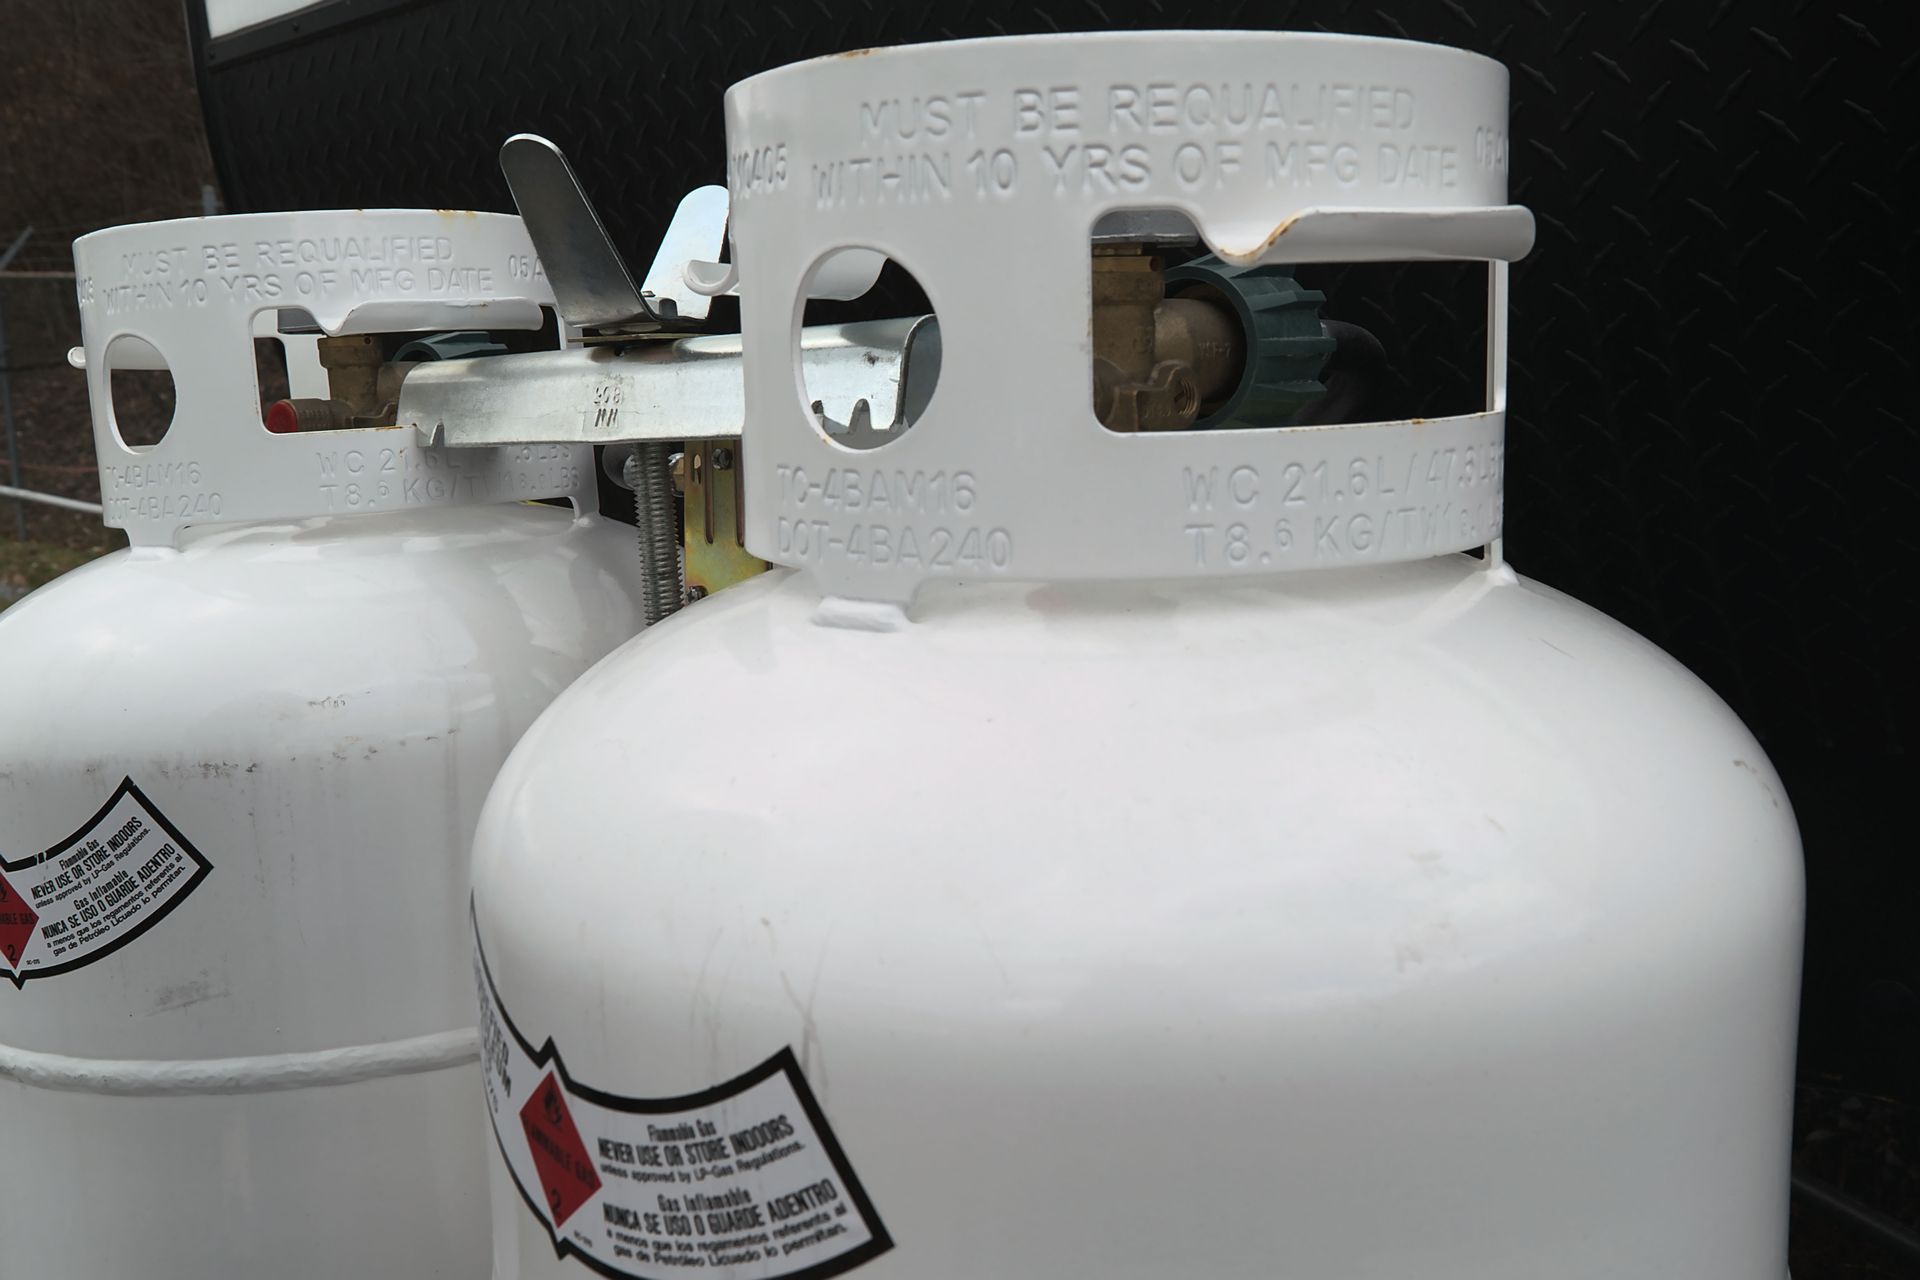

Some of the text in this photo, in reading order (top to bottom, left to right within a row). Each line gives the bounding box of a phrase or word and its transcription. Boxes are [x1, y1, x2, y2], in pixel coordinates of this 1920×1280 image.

[859, 81, 1416, 151] MUST BE REQUALIFIED
[811, 138, 1459, 213] WITHIN 10 YRS OF MFG DATE
[122, 236, 455, 281] MUST BE REQUALIFIED
[102, 281, 173, 315] WITHIN
[180, 277, 209, 309] 10
[219, 273, 283, 304] YRS
[295, 268, 338, 297] OF
[350, 267, 416, 296] MFG
[426, 266, 495, 293] DATE
[777, 463, 977, 517] TC-4BAM16
[31, 816, 142, 900] NEVER USE OR STORE INDOORS
[35, 828, 151, 909] unless approved by LP-Gas Regulations.
[59, 839, 100, 870] Flammable Gas
[41, 843, 176, 940] NUNCA SE USO O GUARDE ADENTRO
[53, 934, 75, 947] menos
[76, 926, 90, 937] que
[90, 920, 102, 929] los
[176, 853, 184, 863] al
[53, 947, 67, 958] gas
[68, 941, 78, 951] de
[110, 904, 142, 927] Licuado
[143, 896, 151, 905] lo
[151, 866, 186, 899] permitan.
[73, 870, 129, 911] Gas Inflamable
[7, 943, 17, 963] 2
[598, 1113, 795, 1167] NEVER USE OR STORE INDOORS
[657, 1192, 681, 1212] Gas
[677, 1169, 692, 1184] by
[603, 1178, 838, 1237] NUNCA SE USO O GUARDE ADENTRO
